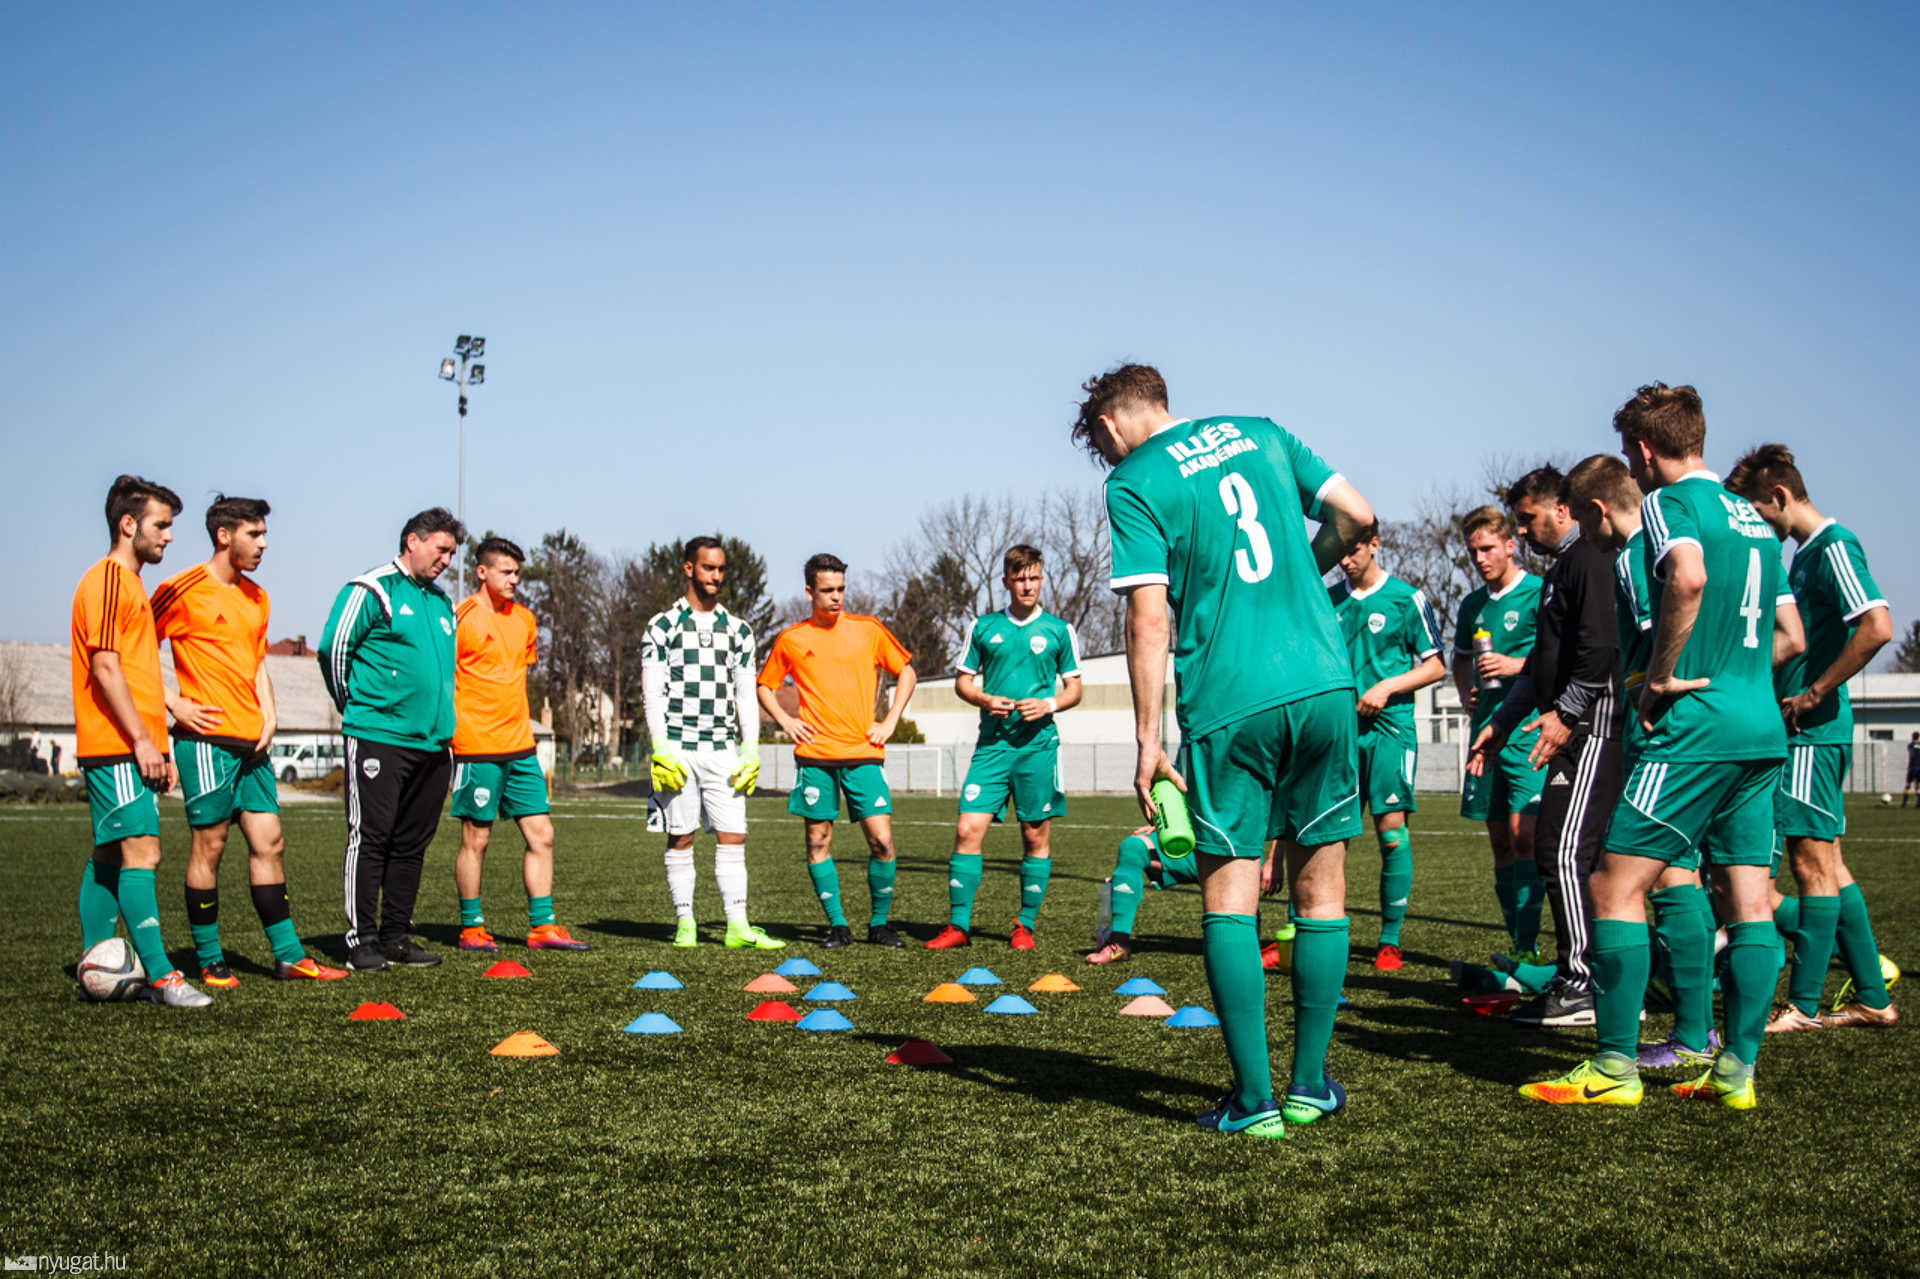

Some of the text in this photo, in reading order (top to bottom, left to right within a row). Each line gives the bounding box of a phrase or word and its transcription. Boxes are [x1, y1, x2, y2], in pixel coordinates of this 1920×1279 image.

[1165, 422, 1242, 462] ILLÉS
[1178, 437, 1259, 479] AKADÉMIA
[1218, 472, 1274, 584] 3
[1739, 547, 1762, 648] 4
